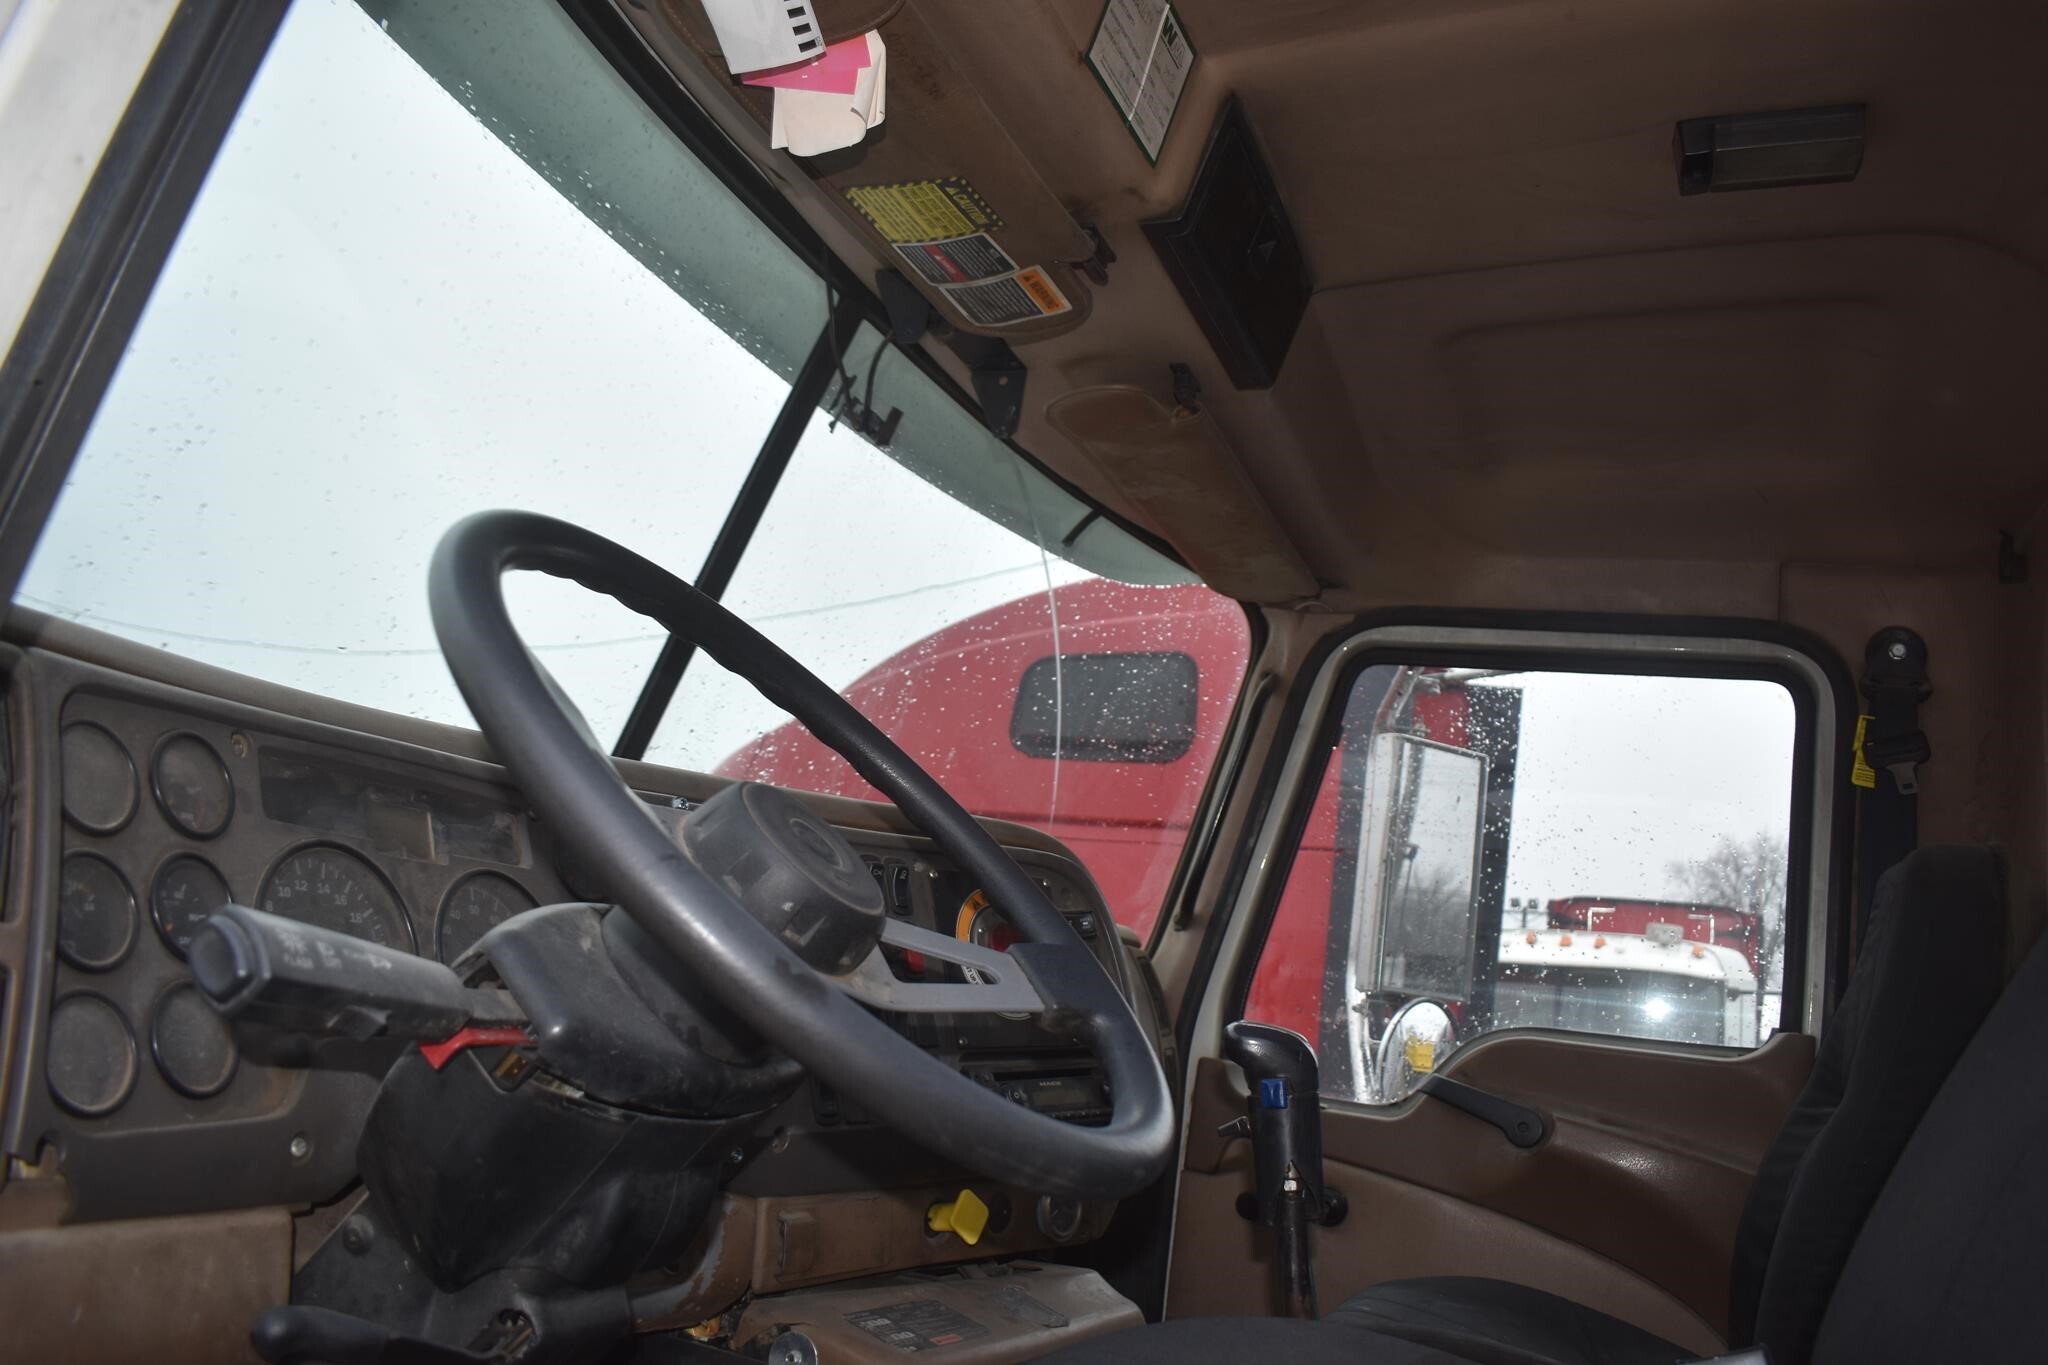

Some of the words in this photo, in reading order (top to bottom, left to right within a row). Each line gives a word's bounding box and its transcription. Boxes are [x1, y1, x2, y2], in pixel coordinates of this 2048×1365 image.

[278, 886, 291, 898] 10
[294, 880, 308, 891] 12
[317, 883, 330, 894] 14
[350, 912, 363, 923] 18
